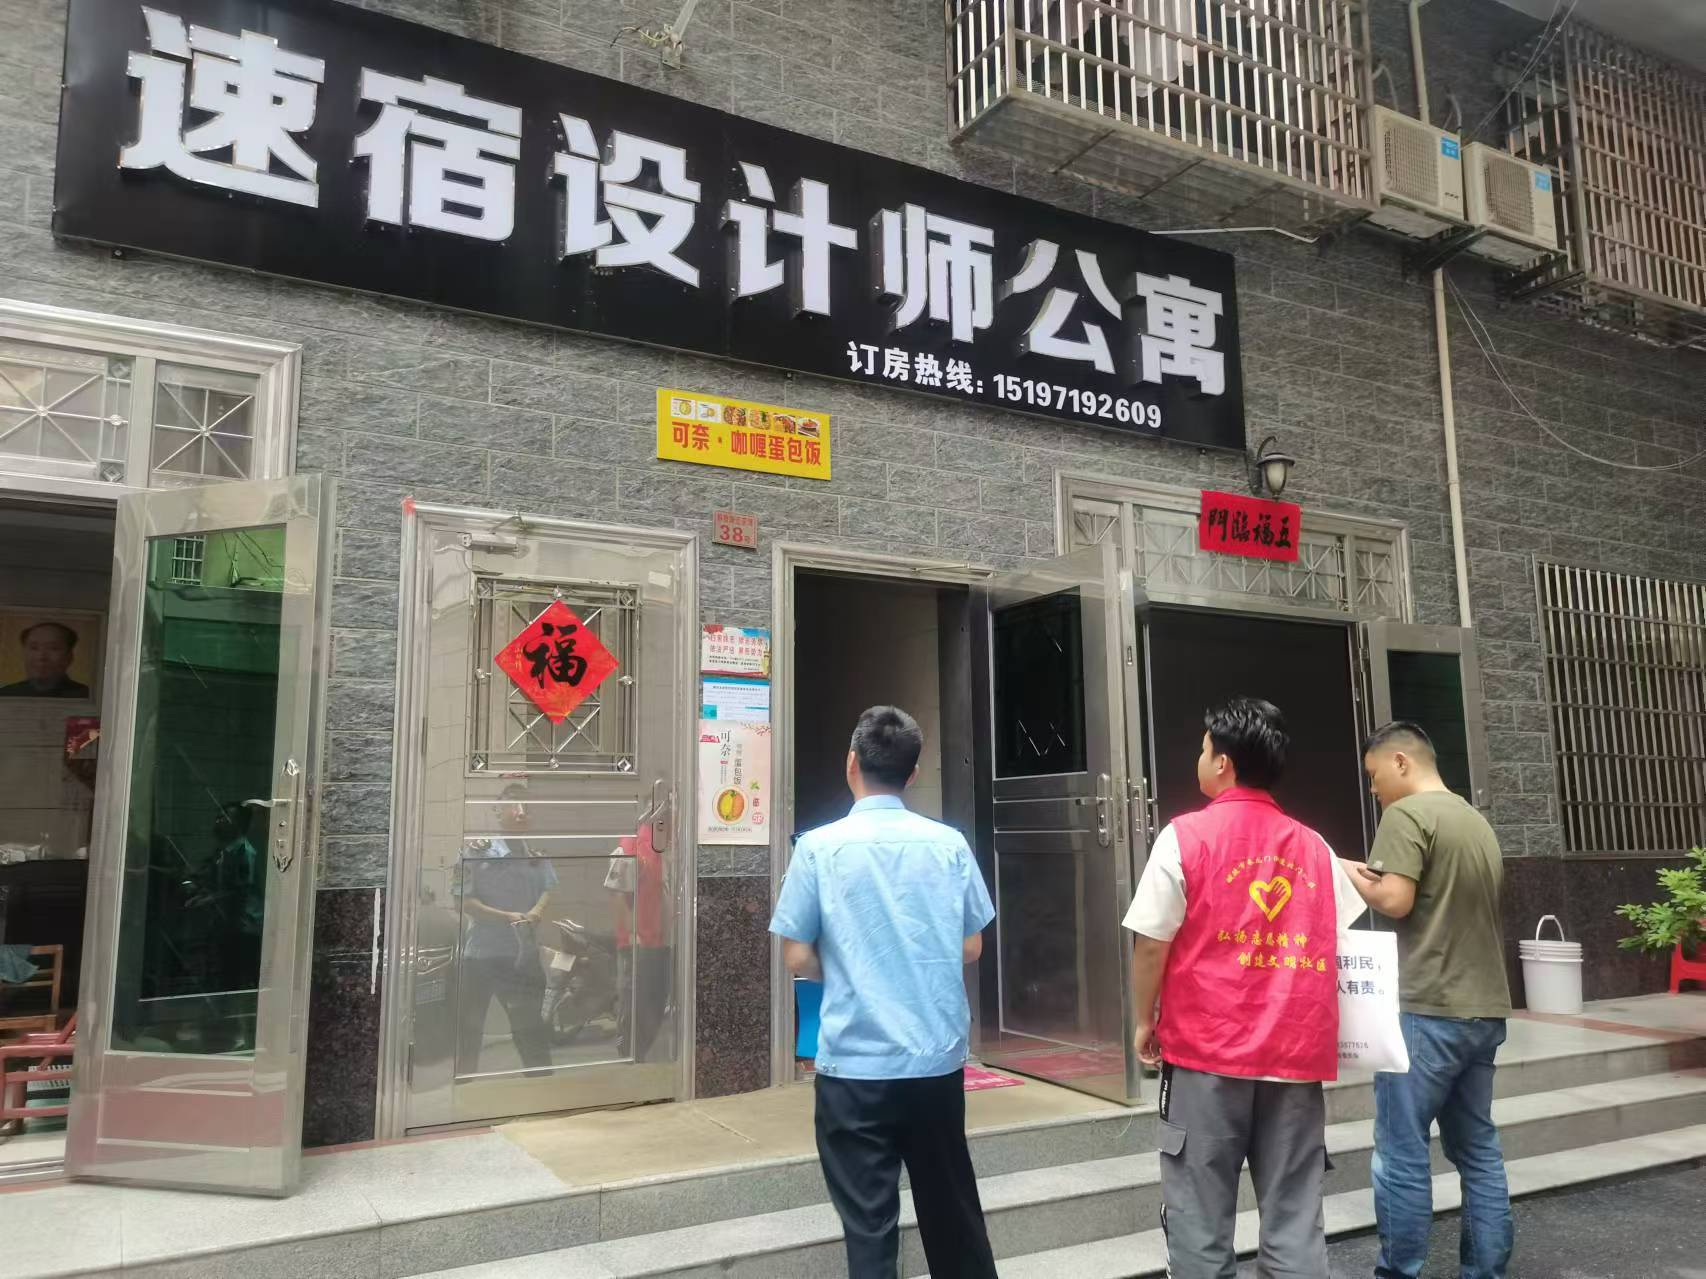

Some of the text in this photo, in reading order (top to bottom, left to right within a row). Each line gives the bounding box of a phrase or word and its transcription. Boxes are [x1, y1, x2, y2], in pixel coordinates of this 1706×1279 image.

[119, 5, 1226, 396] 速宿设计师公寓
[993, 373, 1162, 429] 15197192609
[523, 622, 588, 689] 福
